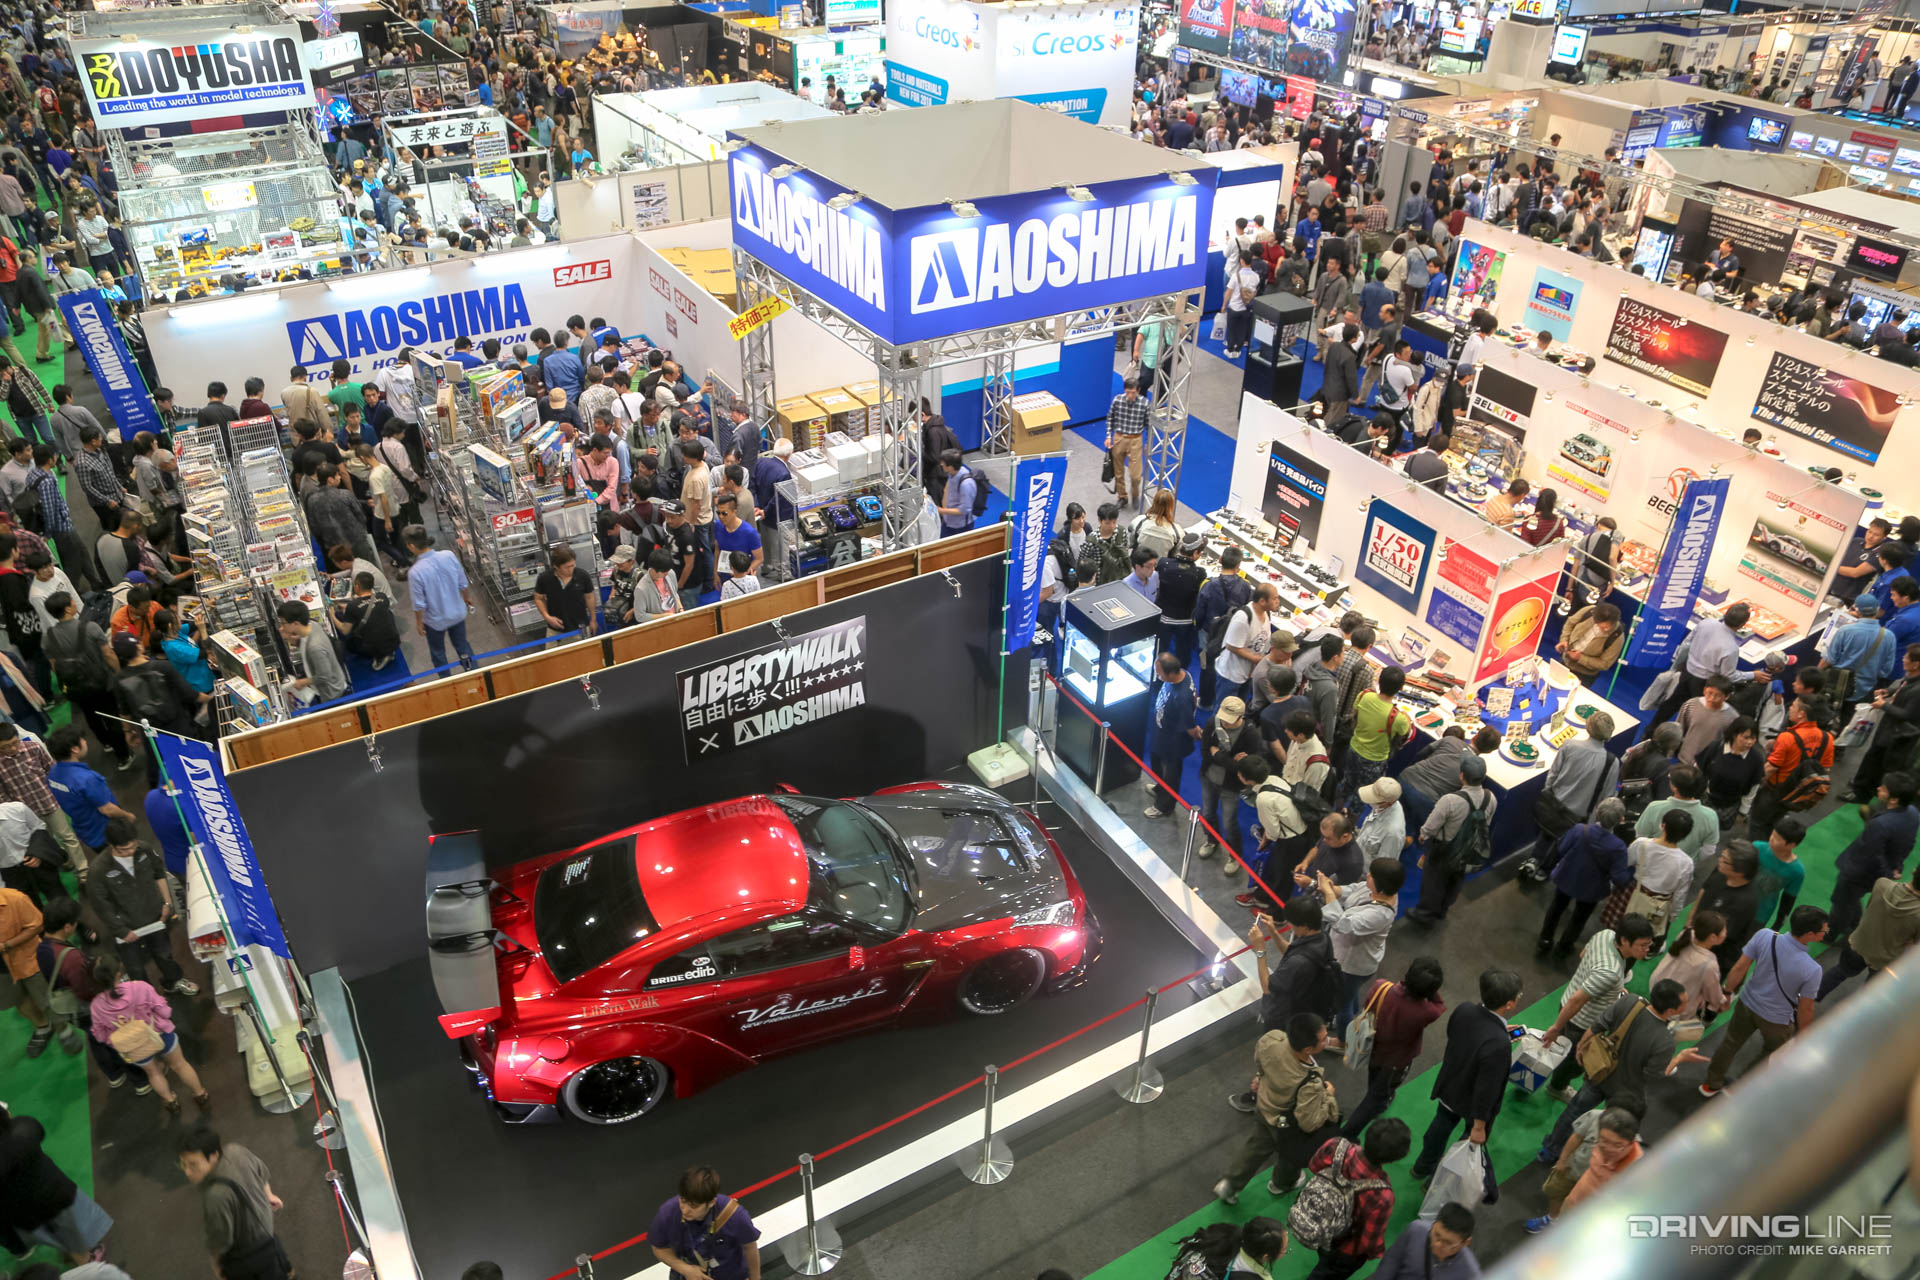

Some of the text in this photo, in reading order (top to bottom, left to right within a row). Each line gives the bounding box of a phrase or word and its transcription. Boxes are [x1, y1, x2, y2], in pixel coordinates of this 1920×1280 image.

[1515, 0, 1540, 15] ACE
[915, 16, 959, 48] Creos
[1032, 32, 1105, 56] Creos
[119, 38, 303, 97] DOYUSHA
[891, 68, 942, 96] TOOLS AND MATERIALS
[104, 85, 302, 114] Leading the world in model technology.
[899, 86, 910, 99] NEW
[911, 90, 921, 103] FOR
[409, 121, 492, 143] 未来と遊ぶ
[1400, 108, 1427, 124] TOMYTEC
[762, 172, 886, 312] AOSHIMA
[977, 195, 1196, 304] AOSHIMA
[555, 262, 609, 285] SALE
[650, 269, 670, 300] SALE
[346, 282, 531, 358] AOSHIMA
[674, 290, 697, 323] SALE
[729, 296, 788, 336] 特価コーナ
[1614, 323, 1670, 351] プラモデルの
[1617, 312, 1671, 337] カスタムカー
[82, 320, 132, 391] AOSHIMA
[1611, 333, 1644, 356] 新定番。
[1607, 346, 1674, 380] The Tuned Car
[1766, 380, 1831, 413] プラモデルの
[1769, 368, 1837, 399] スケールカー
[1473, 395, 1518, 423] BELKITS
[1760, 392, 1800, 417] 新定番。
[1754, 405, 1836, 444] The Model Car
[1271, 458, 1325, 496] 1/12 完成品バイク
[1792, 503, 1818, 521] BEEMAX
[1818, 513, 1846, 532] BEEMAX
[1022, 497, 1048, 591] AOSHIMA
[1376, 523, 1420, 562] 1/50
[1371, 541, 1416, 577] SCALE
[1660, 518, 1708, 609] AOSHIMA
[1761, 576, 1786, 595] BEEMAX
[1786, 588, 1814, 608] BEEMAX
[683, 624, 864, 712] LIBERTYWALK
[763, 681, 866, 737] AOSHIMA
[193, 784, 253, 888] AOSHIMA
[650, 966, 716, 986] BRIDE edirb
[581, 995, 660, 1018] Liberty Walk
[738, 986, 887, 1023] Valenti
